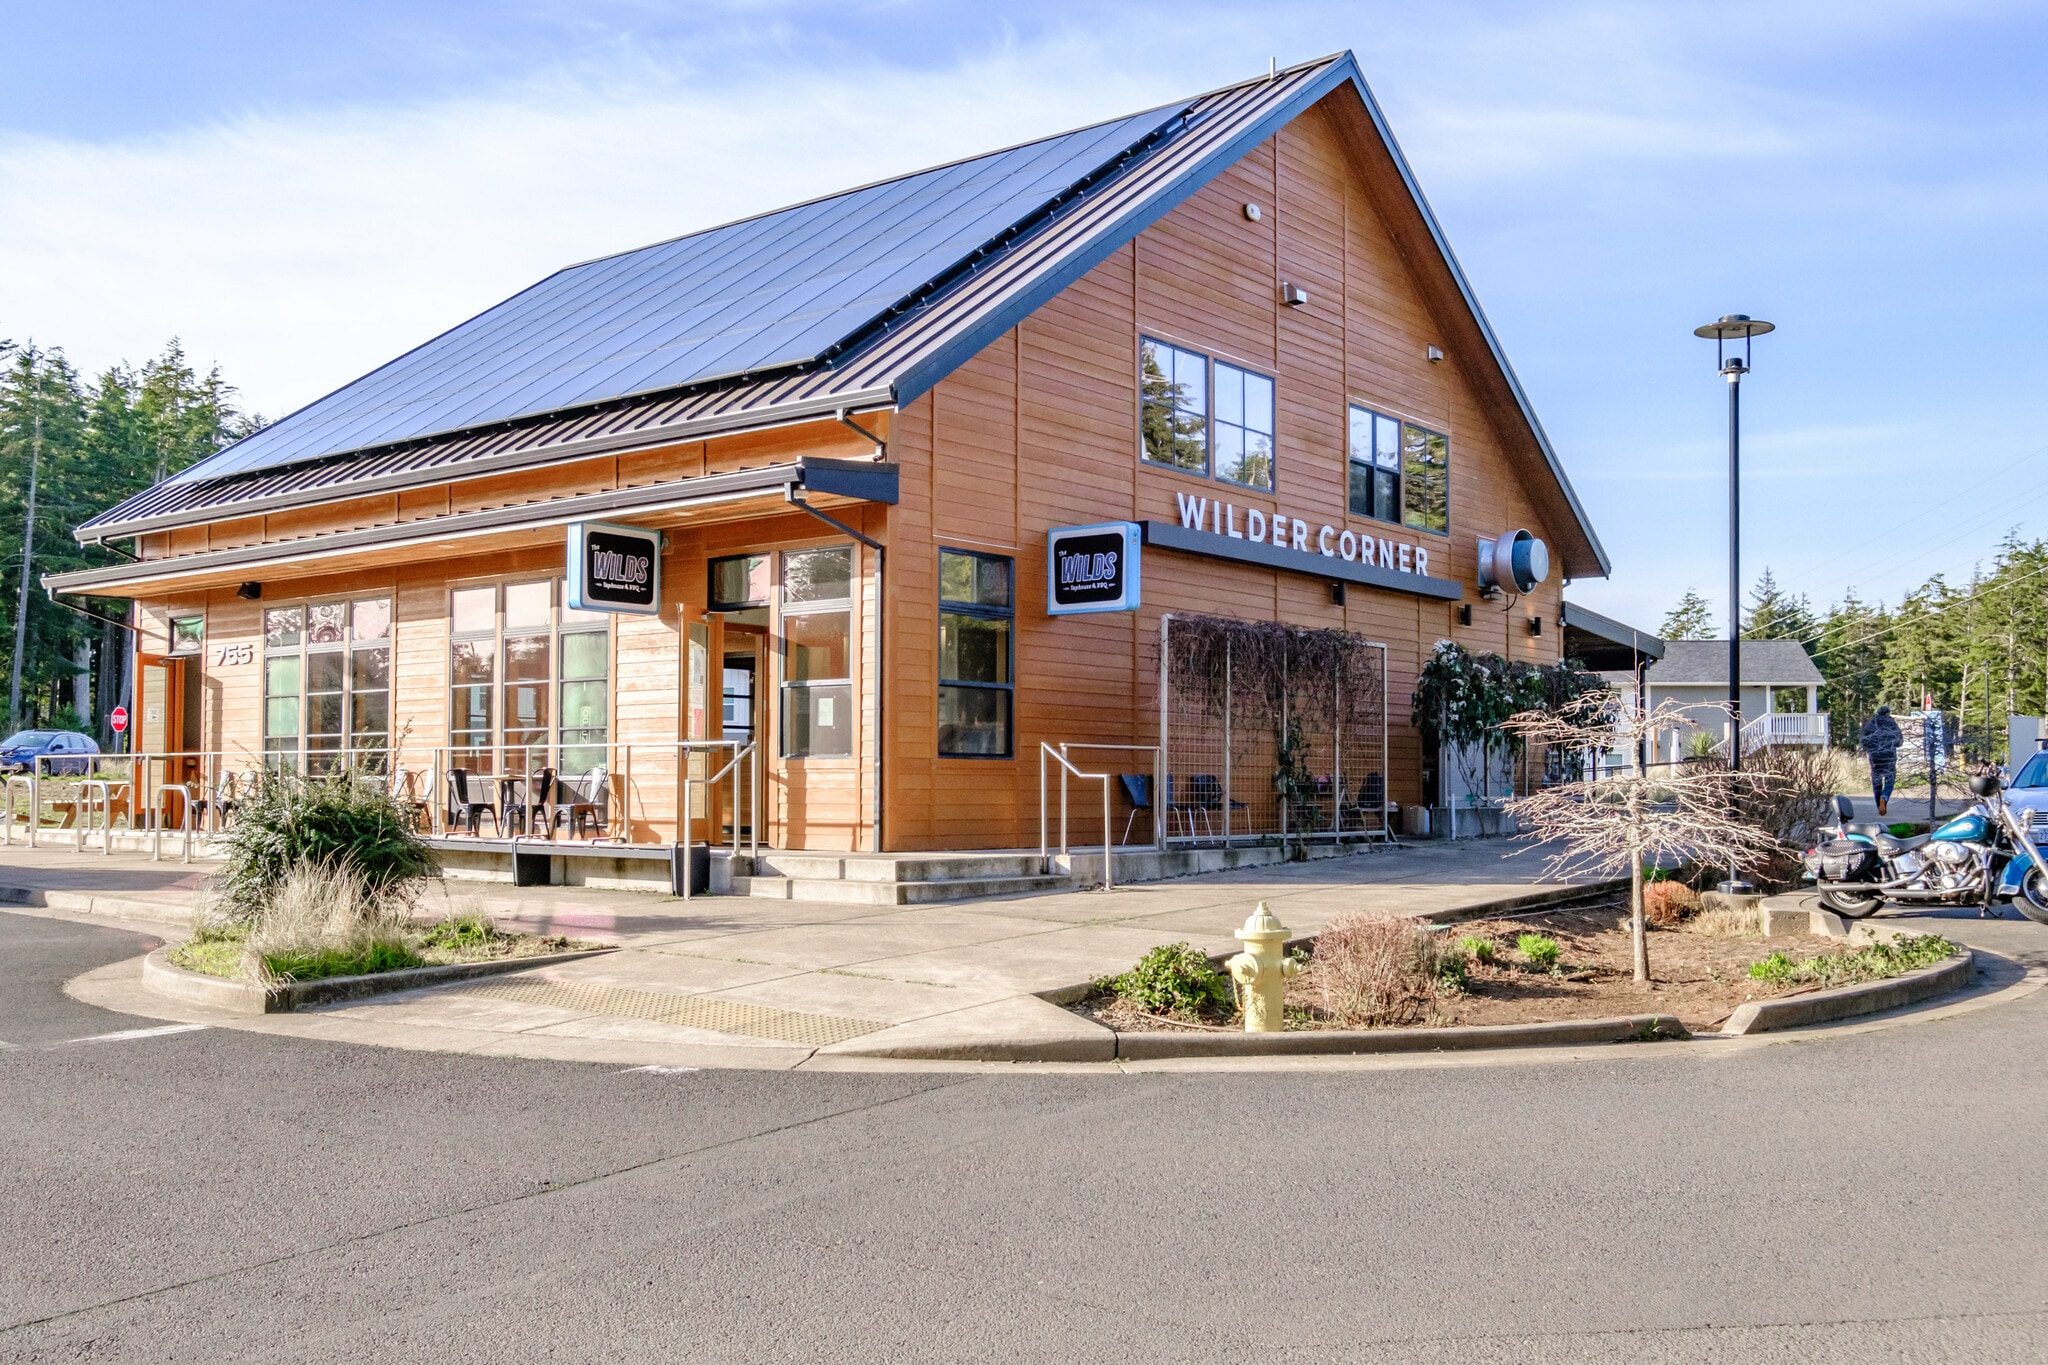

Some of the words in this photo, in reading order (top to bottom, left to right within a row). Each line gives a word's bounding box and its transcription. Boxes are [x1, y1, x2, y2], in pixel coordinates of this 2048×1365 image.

[1177, 492, 1308, 552] WILDER
[1319, 525, 1428, 577] CORNER
[594, 550, 649, 584] WILDS
[1062, 552, 1117, 583] WILDS
[216, 644, 254, 667] 755
[112, 714, 127, 725] STOP
